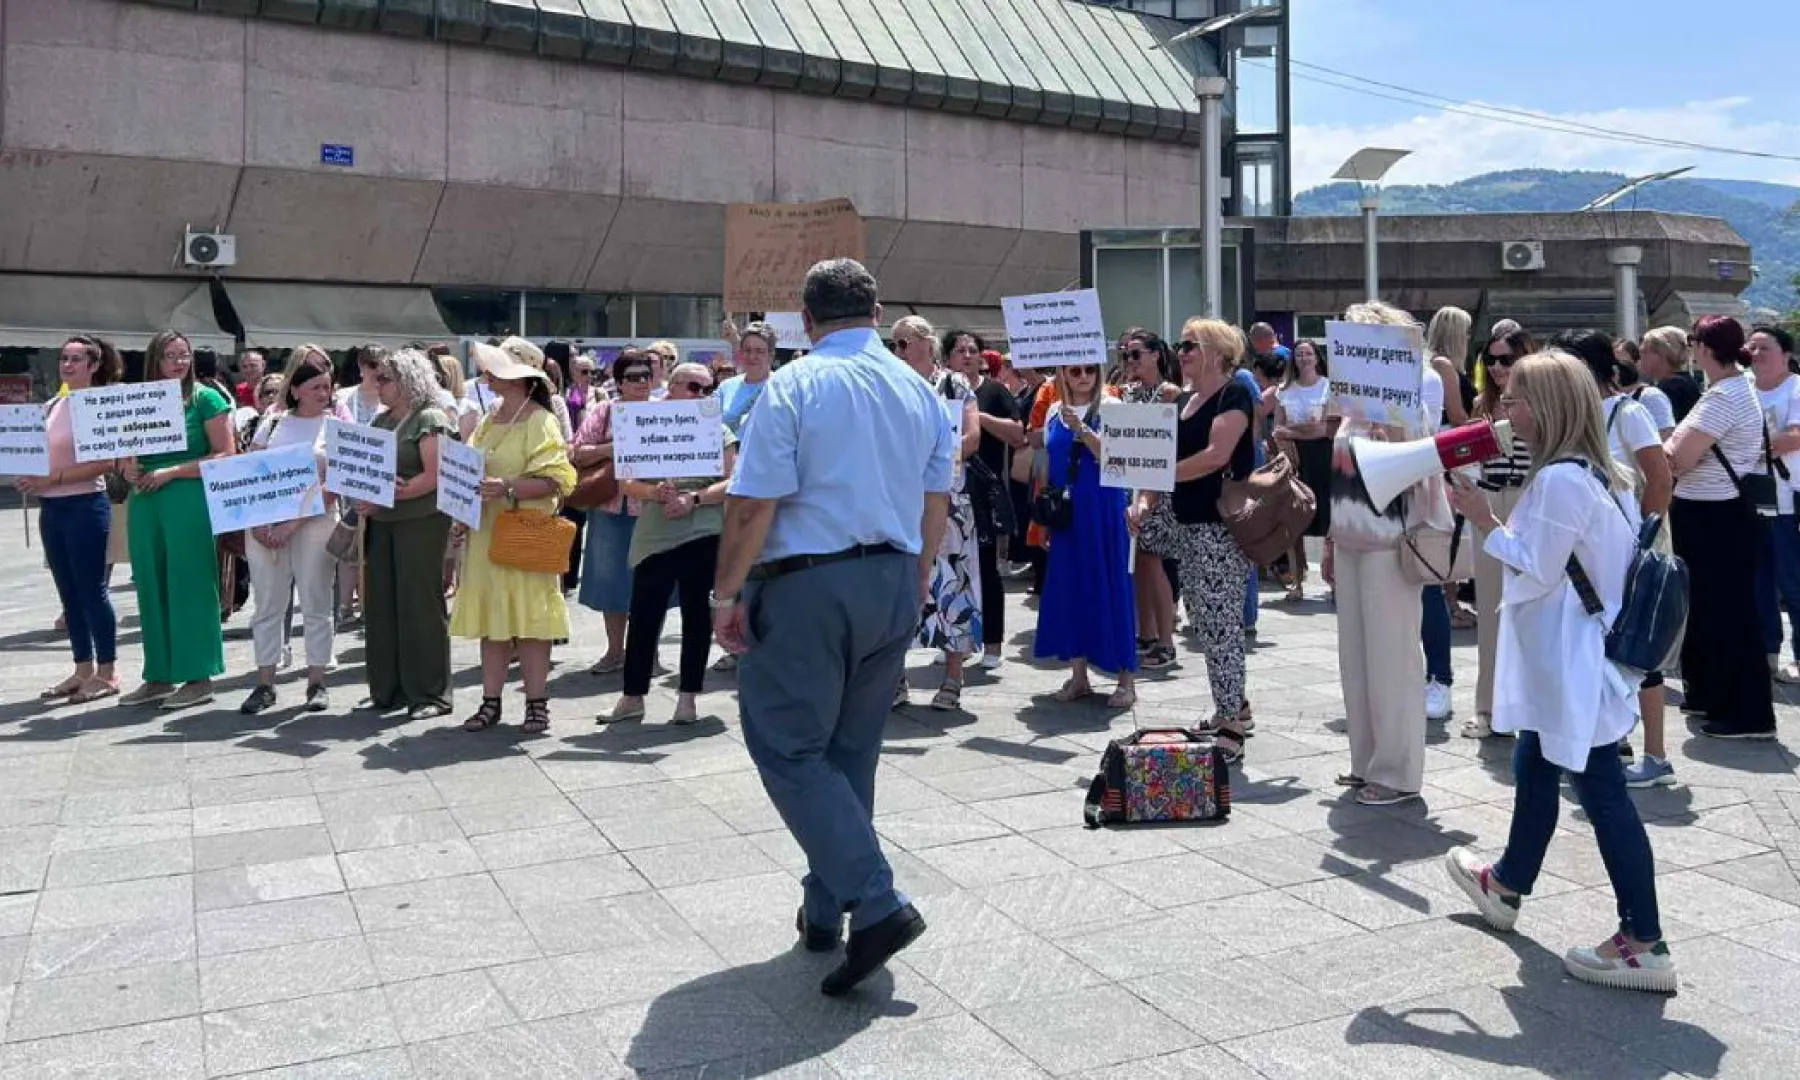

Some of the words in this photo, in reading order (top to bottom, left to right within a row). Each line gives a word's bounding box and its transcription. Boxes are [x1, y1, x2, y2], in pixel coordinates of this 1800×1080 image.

[1333, 339, 1345, 356] За
[1345, 342, 1380, 364] осмијех
[1381, 345, 1416, 366] дјетета,
[1350, 383, 1361, 396] на
[84, 396, 98, 405] Не
[100, 392, 124, 406] дирај
[127, 391, 146, 402] оног
[148, 389, 167, 400] који
[96, 412, 103, 420] с
[135, 407, 157, 419] ради
[92, 426, 105, 437] тај
[107, 425, 118, 434] не
[122, 419, 171, 434] заборавља
[1122, 427, 1136, 438] као
[78, 444, 91, 452] он
[92, 441, 116, 453] своју
[117, 436, 143, 449] борбу
[145, 433, 182, 446] планира
[663, 452, 695, 463] мизерна
[1127, 456, 1141, 467] као
[209, 476, 259, 492] Образовање
[261, 472, 277, 484] није
[222, 496, 247, 507] зашто
[248, 495, 256, 505] је
